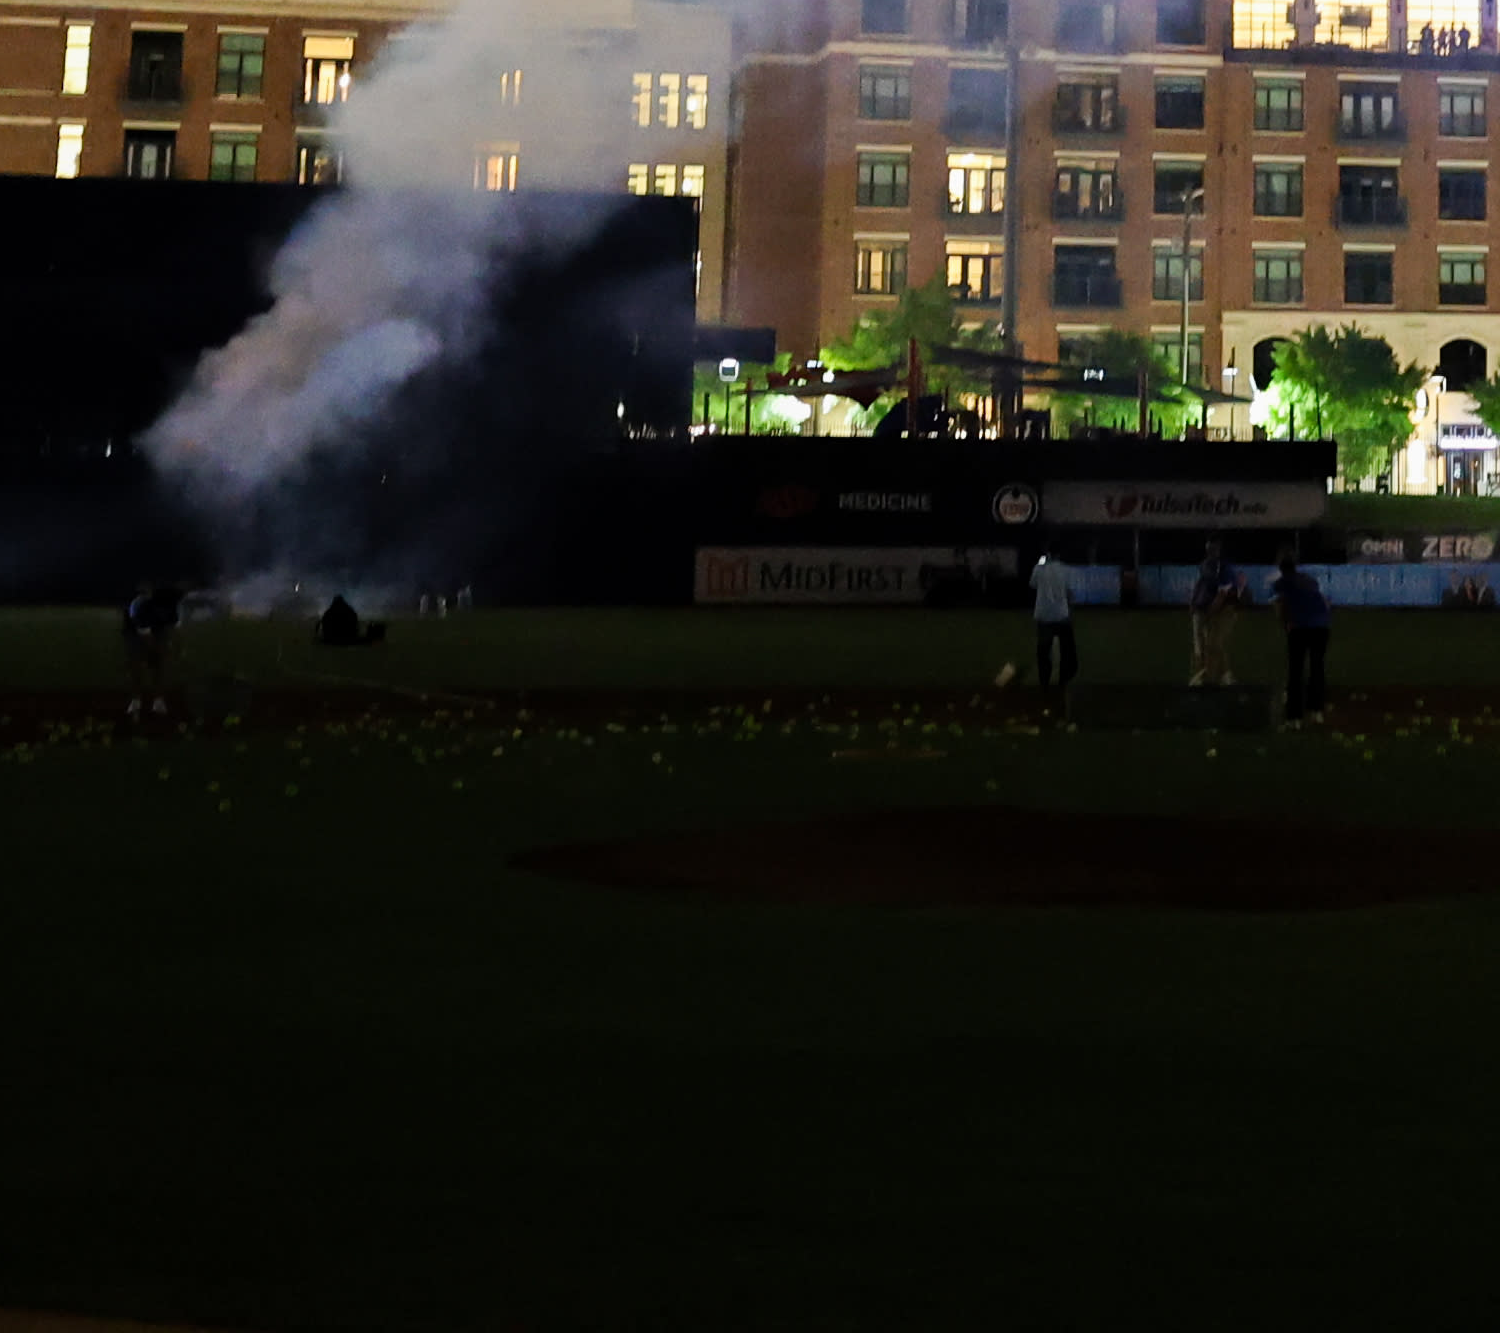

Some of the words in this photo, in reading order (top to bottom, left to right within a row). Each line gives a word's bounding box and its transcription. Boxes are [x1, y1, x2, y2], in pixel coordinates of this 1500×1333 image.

[838, 492, 932, 512] MEDICINE
[1361, 537, 1404, 558] OMNI
[1422, 532, 1494, 559] ZERO
